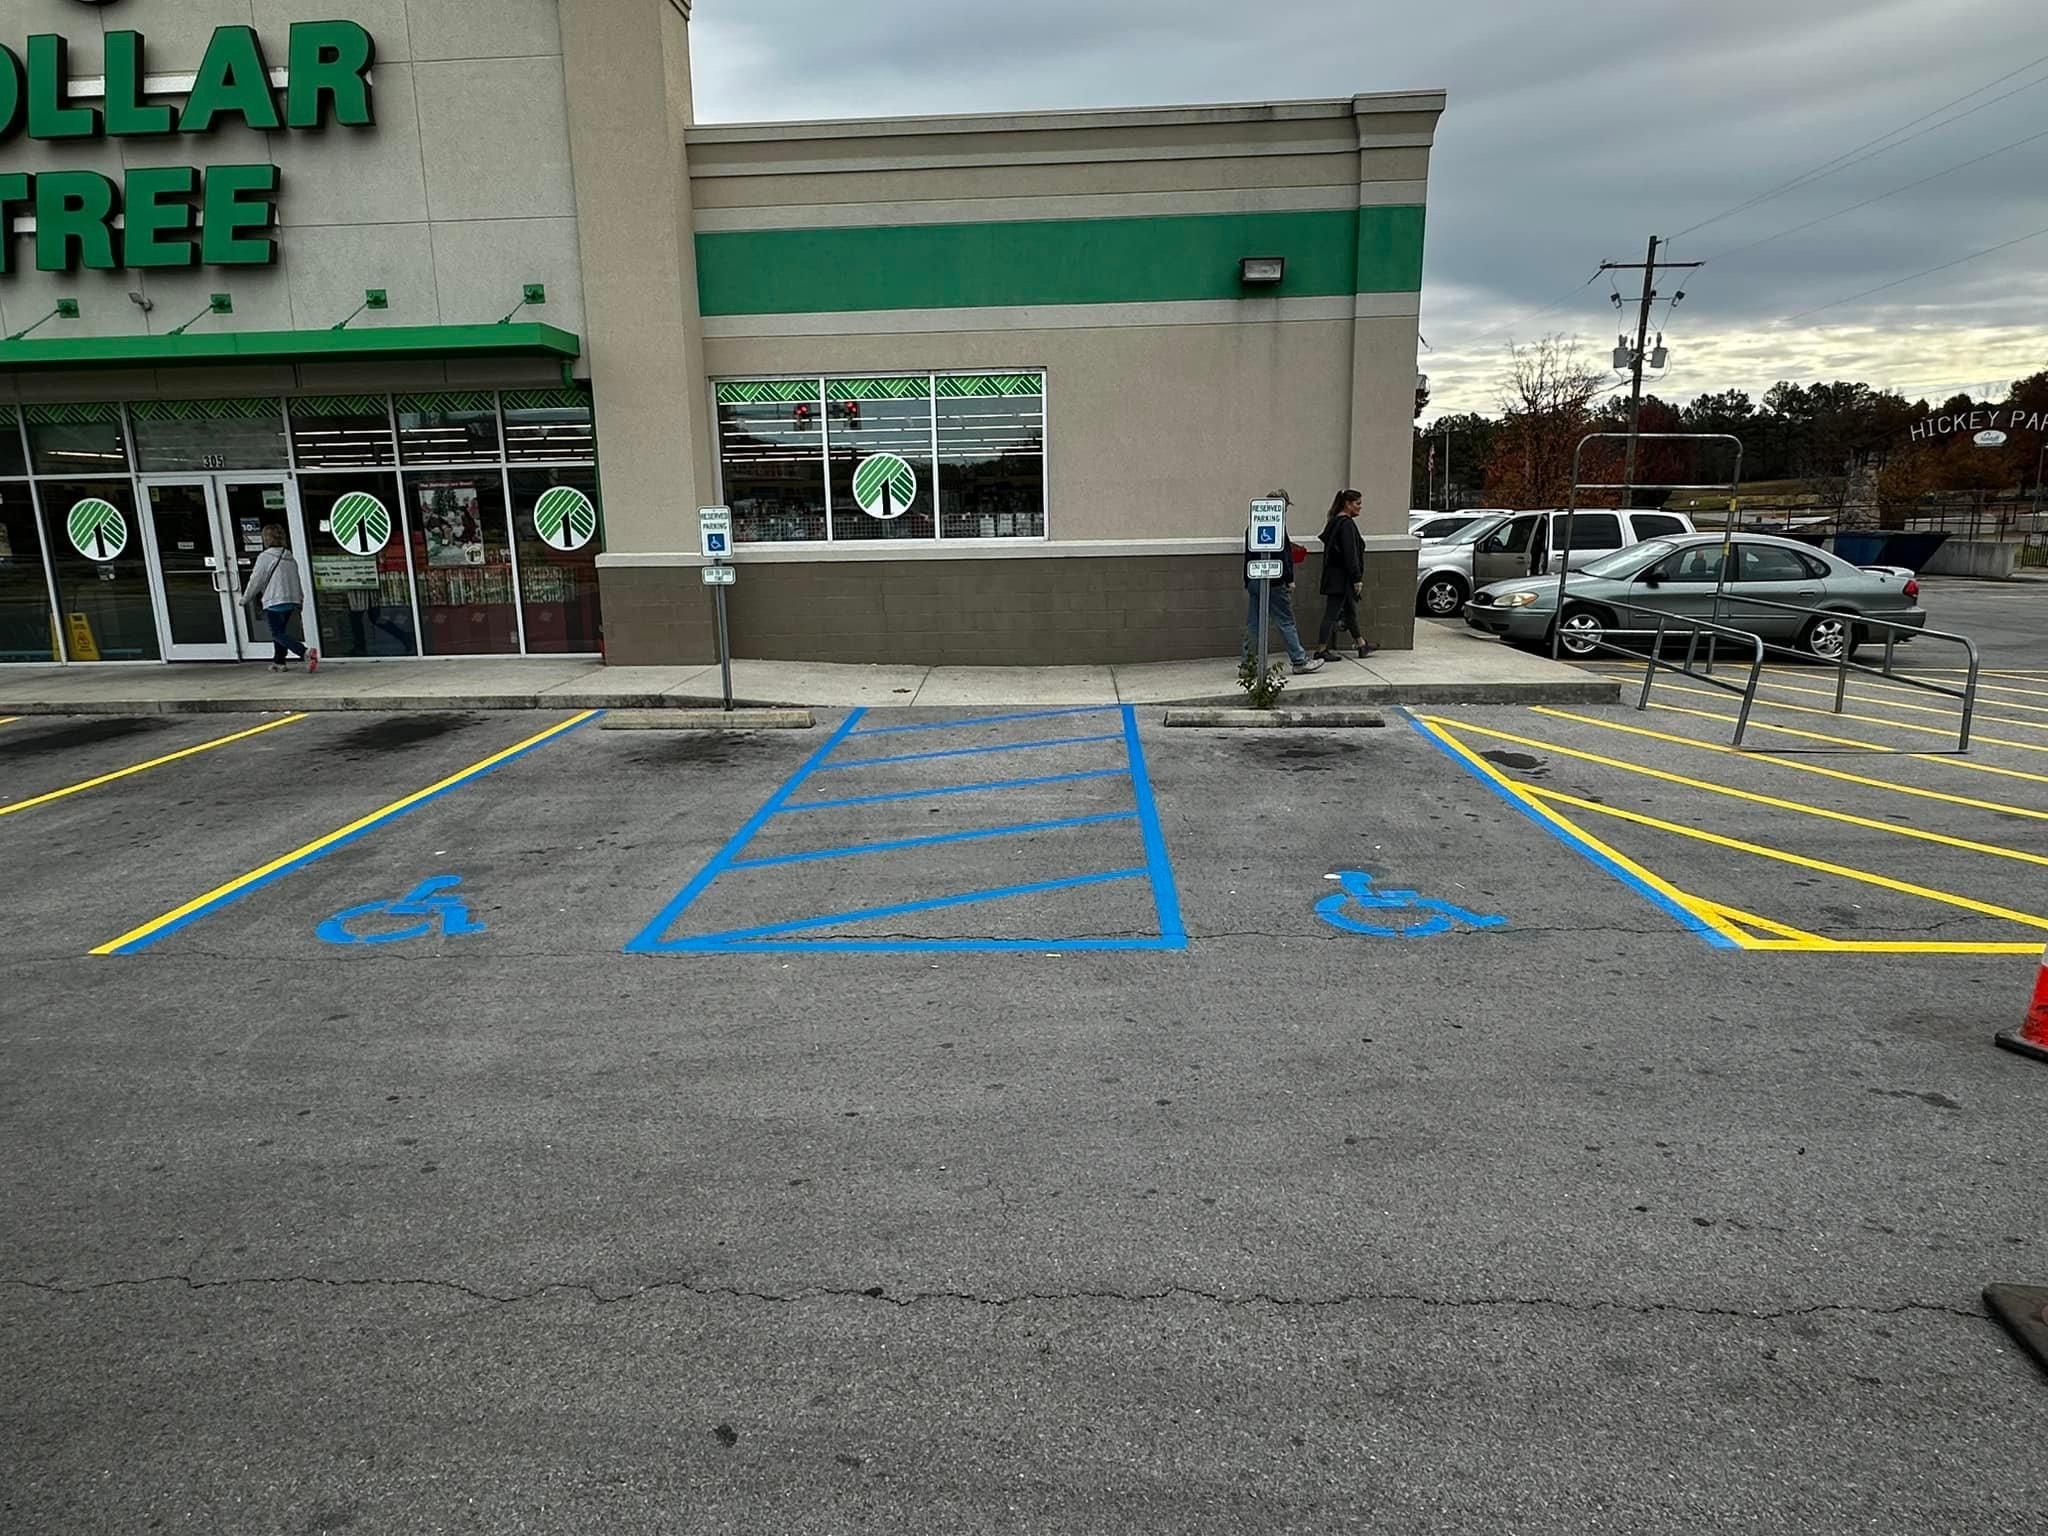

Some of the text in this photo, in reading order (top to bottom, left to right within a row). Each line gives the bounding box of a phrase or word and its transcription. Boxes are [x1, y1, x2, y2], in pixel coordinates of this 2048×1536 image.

[0, 20, 376, 142] LLAR
[1910, 410, 2000, 441] HICKEY
[203, 454, 224, 468] 305
[701, 512, 729, 520] RESERVED
